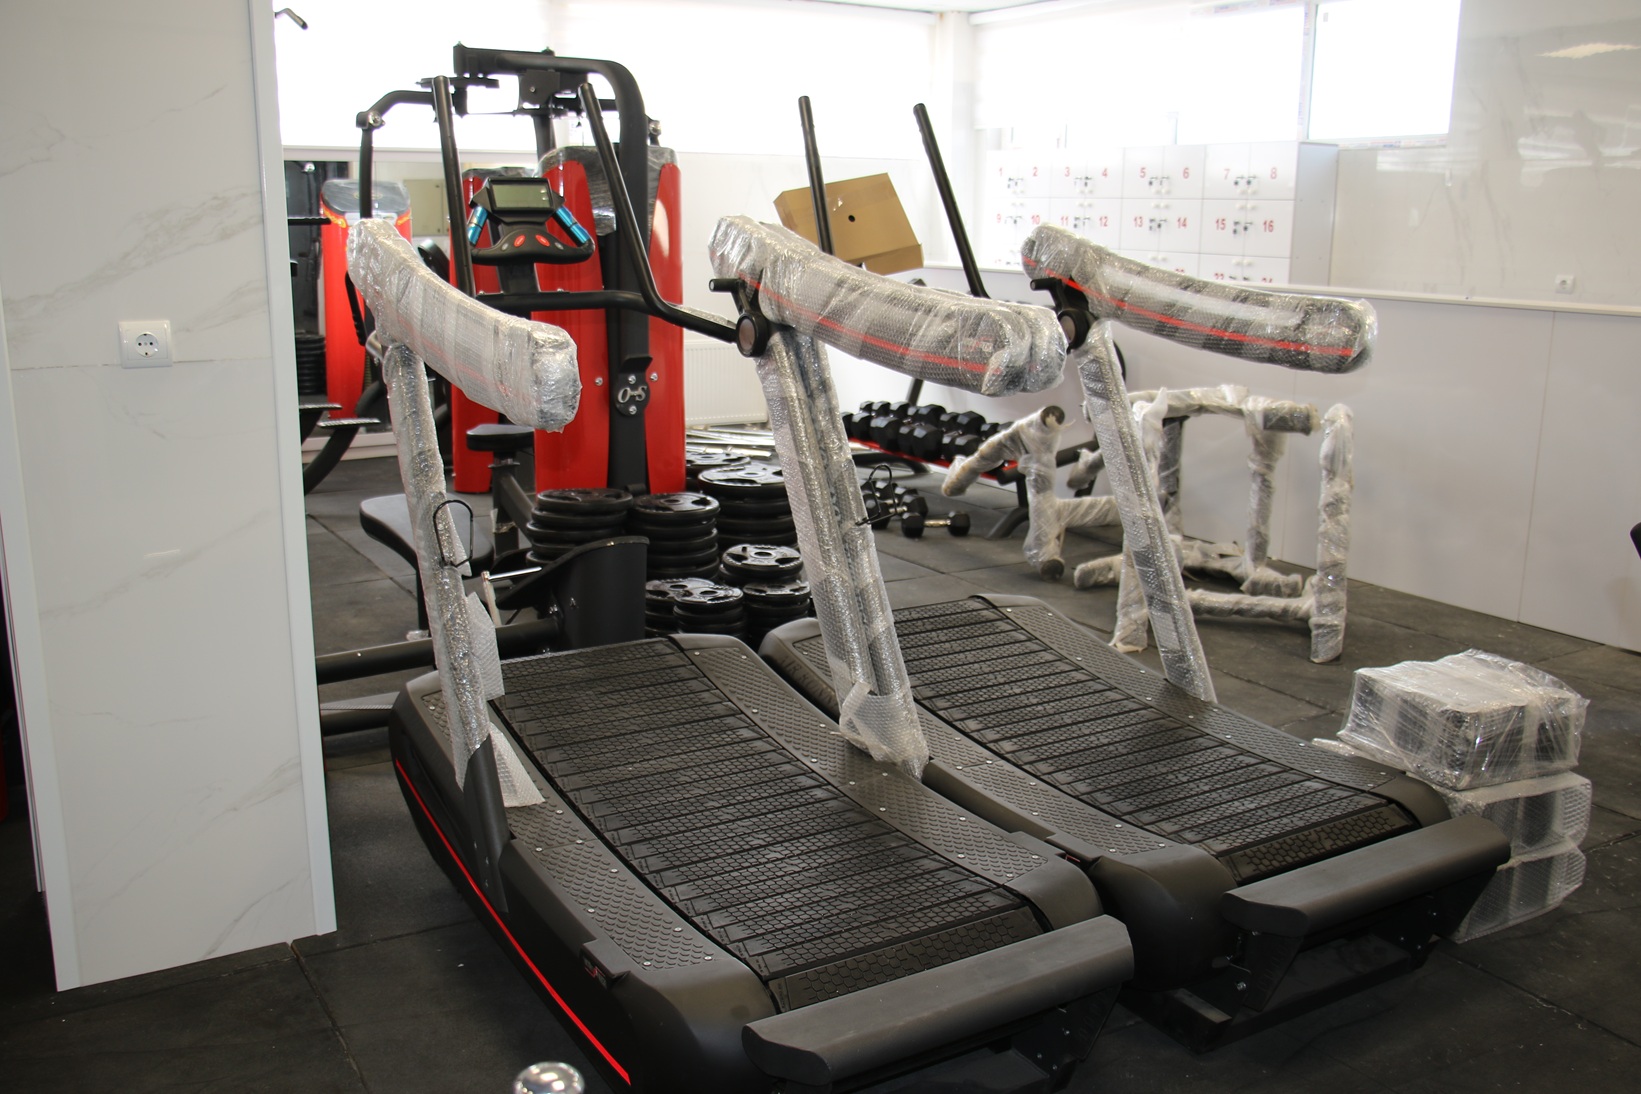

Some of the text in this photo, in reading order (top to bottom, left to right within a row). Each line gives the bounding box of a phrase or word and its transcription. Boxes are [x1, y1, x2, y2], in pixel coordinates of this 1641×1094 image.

[1032, 165, 1039, 177] 2
[1064, 165, 1071, 177] 3
[1101, 167, 1109, 178] 4
[1139, 166, 1147, 179] 5
[1182, 166, 1190, 179] 6
[1223, 167, 1231, 180] 7
[1269, 166, 1278, 180] 8
[996, 213, 1002, 224] 9
[1030, 214, 1041, 225] 10
[1060, 215, 1069, 226] 11
[1098, 215, 1109, 228] 12
[1133, 215, 1144, 228] 13
[1176, 216, 1188, 229] 14
[1215, 217, 1227, 231] 15
[1262, 219, 1275, 233] 16
